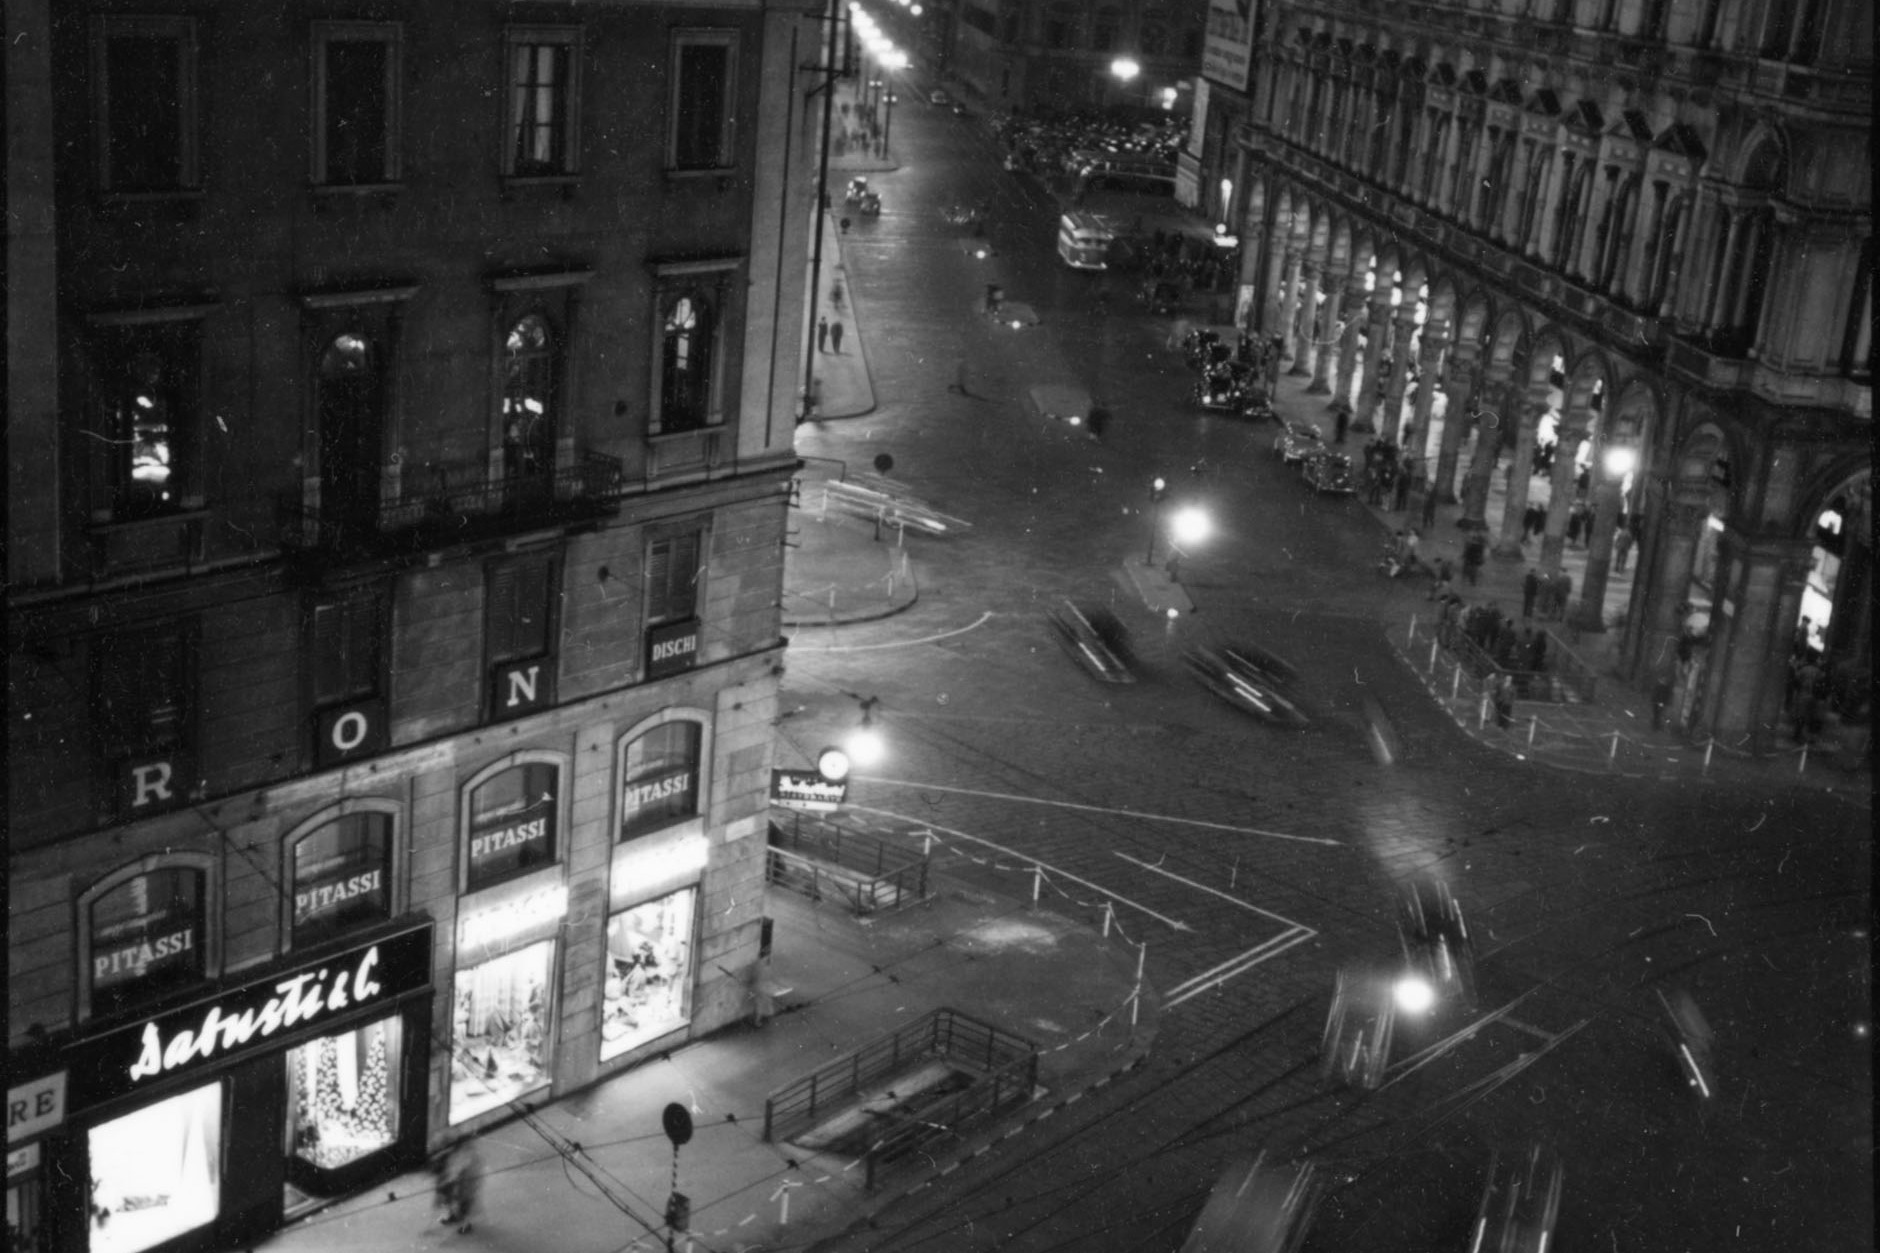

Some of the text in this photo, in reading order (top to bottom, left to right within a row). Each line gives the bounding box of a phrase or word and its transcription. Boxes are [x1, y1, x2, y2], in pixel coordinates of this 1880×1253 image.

[653, 634, 696, 661] DISCHI
[131, 666, 539, 807] R O N
[626, 773, 689, 806] PITASSI
[472, 817, 546, 857] PITASSI
[295, 869, 381, 911] PITASSI
[94, 929, 193, 977] PITASSI
[9, 1090, 55, 1126] RE
